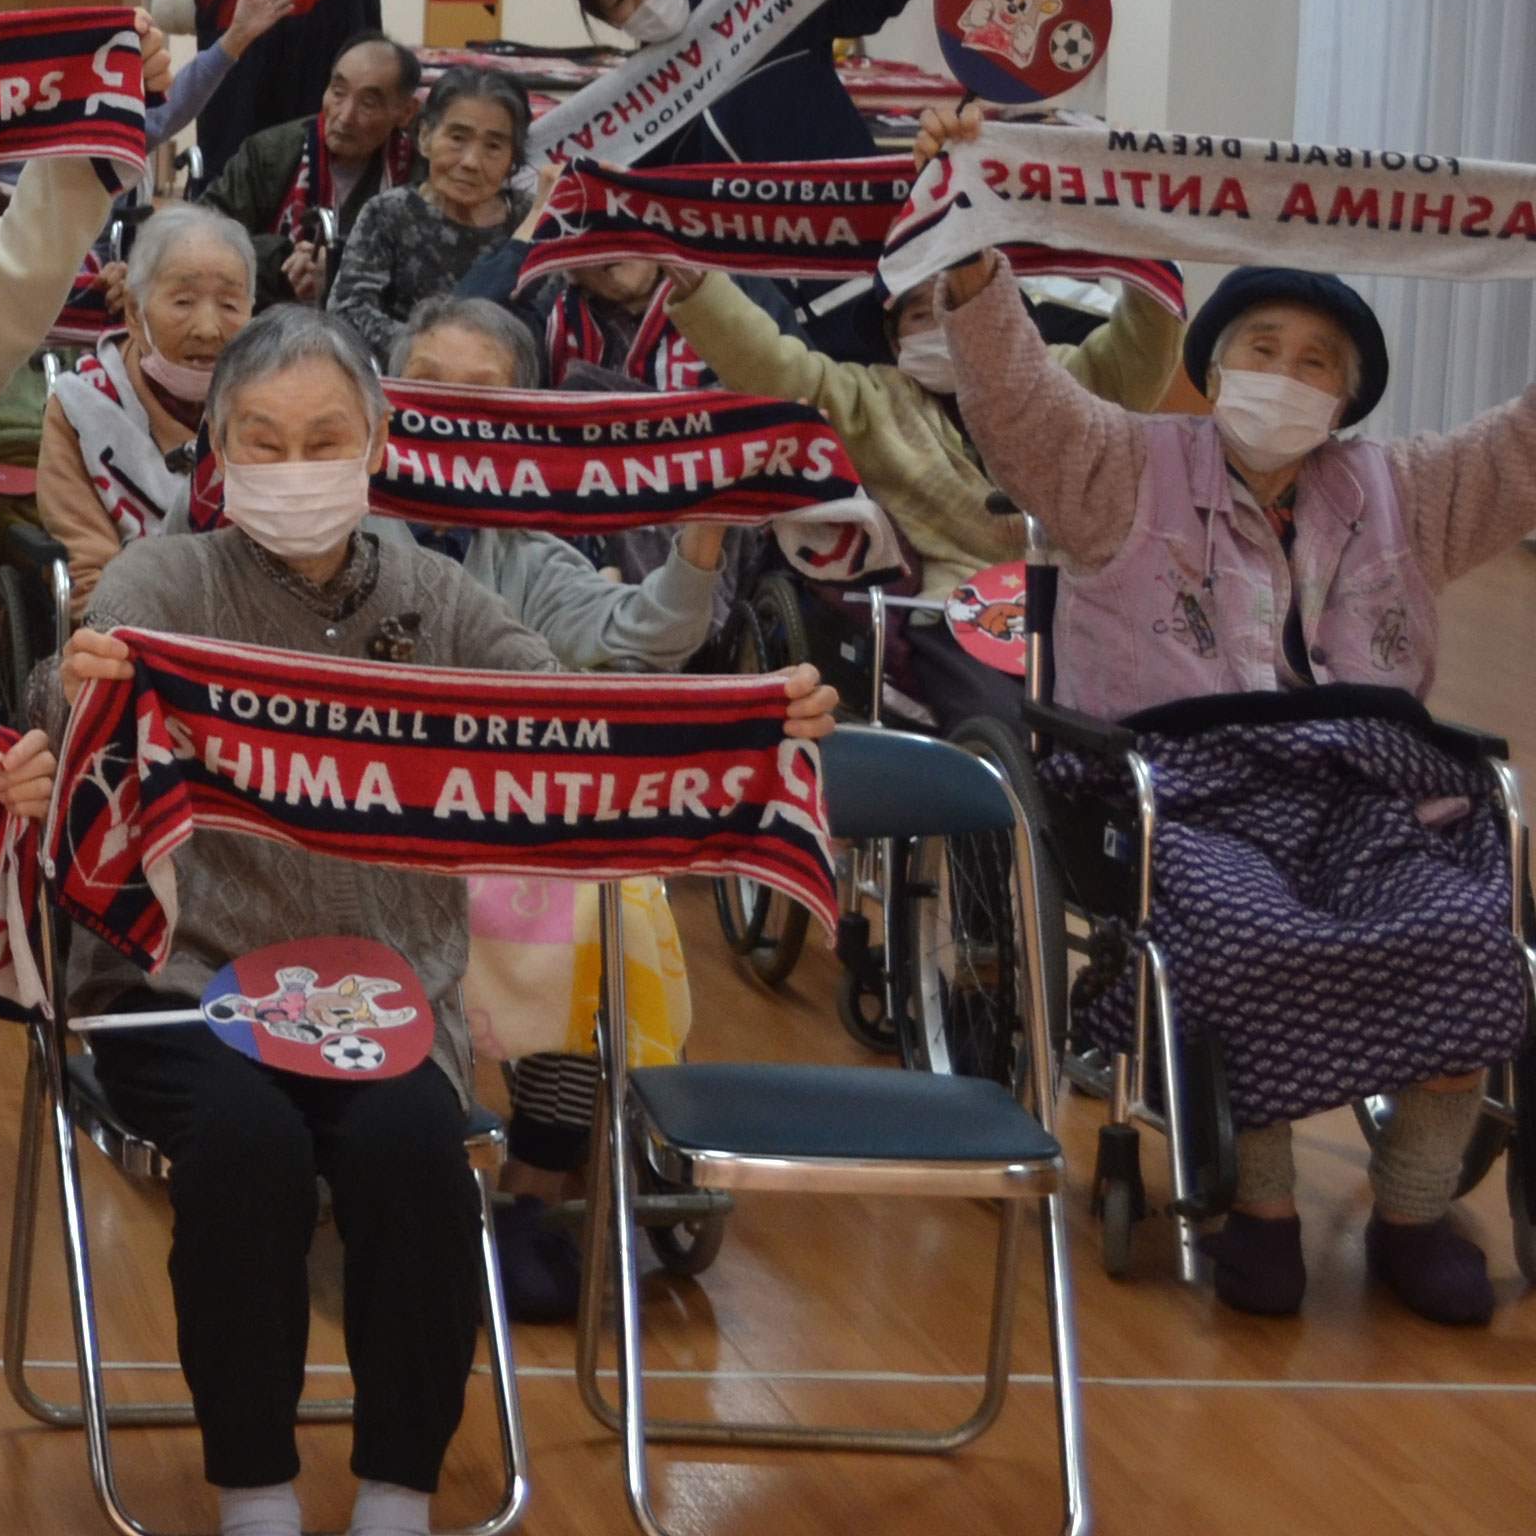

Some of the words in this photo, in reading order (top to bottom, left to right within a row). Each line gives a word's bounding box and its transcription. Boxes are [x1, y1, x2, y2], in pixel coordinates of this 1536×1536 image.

[604, 186, 860, 247] KASHIMA
[711, 177, 875, 202] FOOTBALL
[582, 410, 714, 442] DREAM
[385, 441, 552, 498] HIMA
[576, 437, 839, 499] ANTLERS
[207, 682, 428, 740] FOOTBALL
[453, 712, 611, 749] DREAM
[136, 710, 403, 815] KSHIMA
[433, 765, 755, 825] ANTLERS
